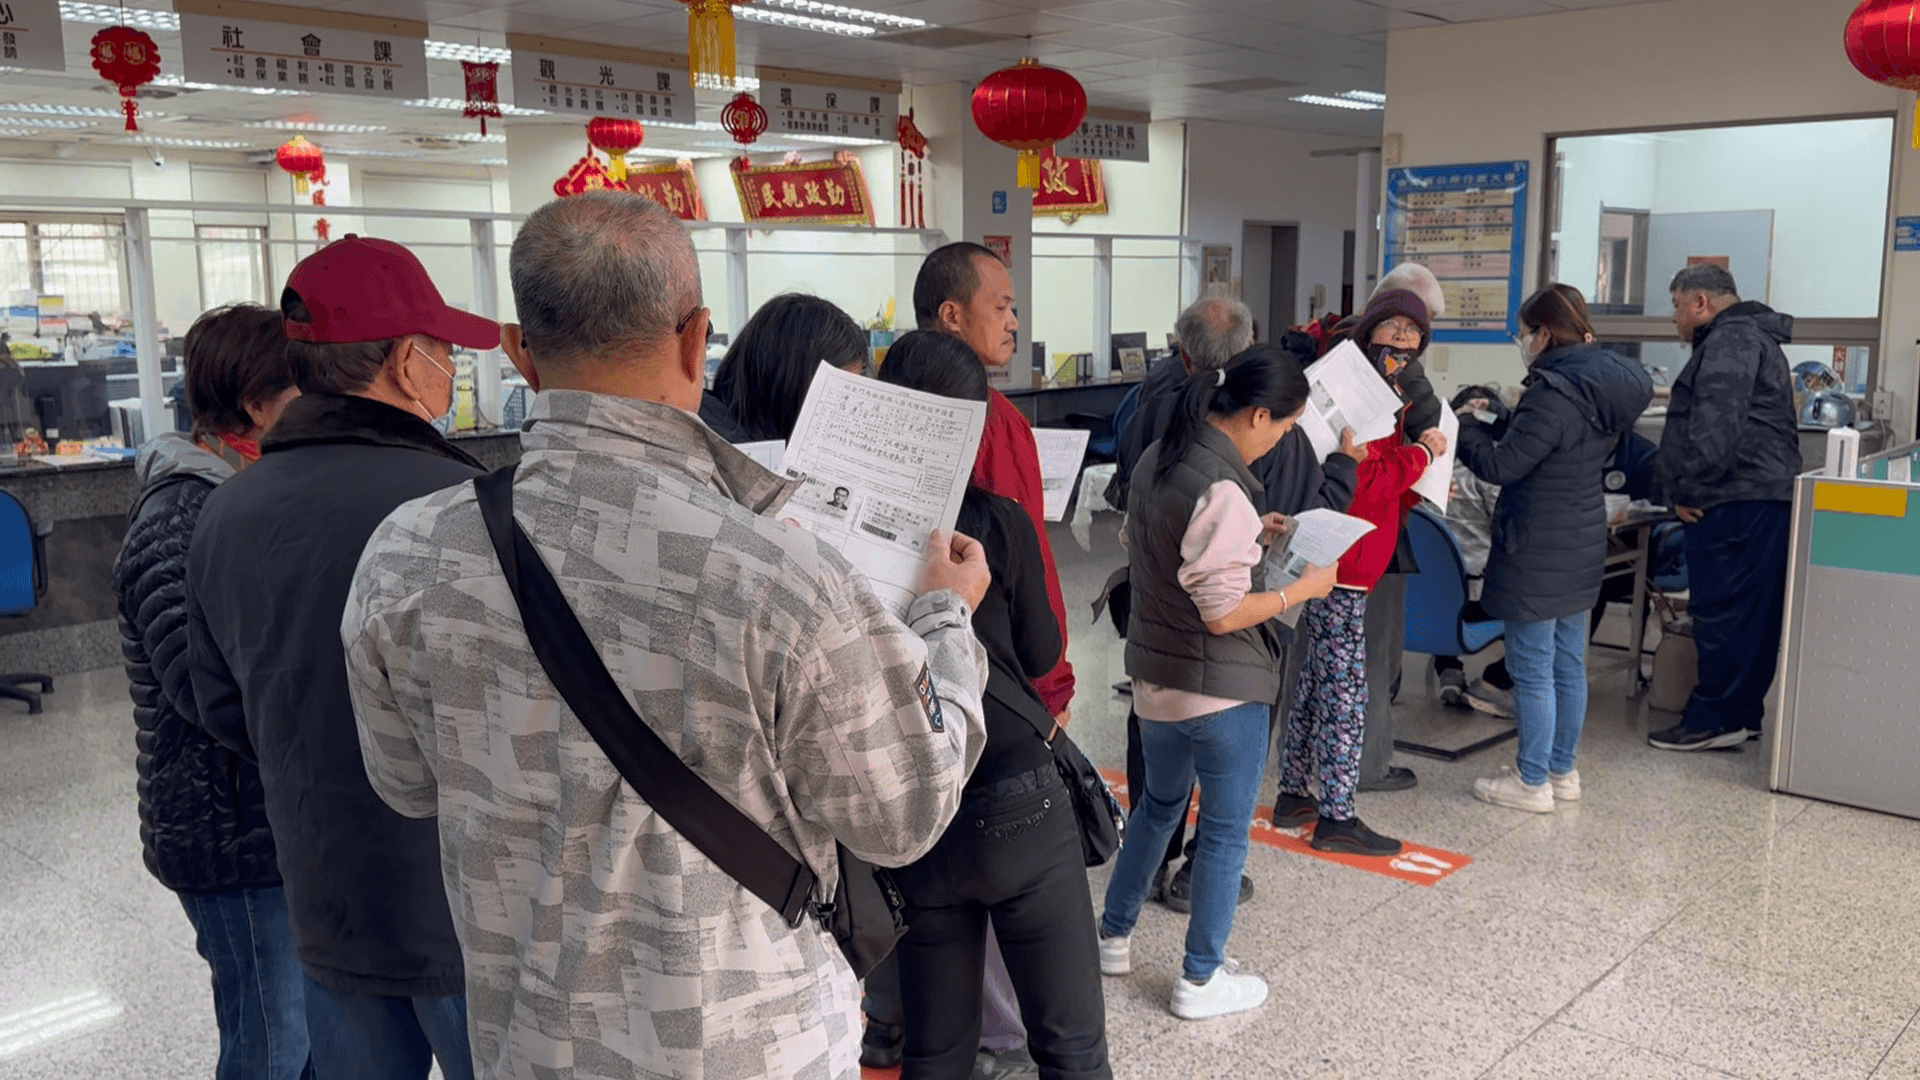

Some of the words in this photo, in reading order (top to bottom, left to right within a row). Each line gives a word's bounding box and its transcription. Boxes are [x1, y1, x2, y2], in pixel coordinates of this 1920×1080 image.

[222, 25, 392, 62] 社會課
[233, 54, 308, 73] 社會福利
[540, 58, 672, 92] 觀光課
[780, 87, 880, 114] 環保課
